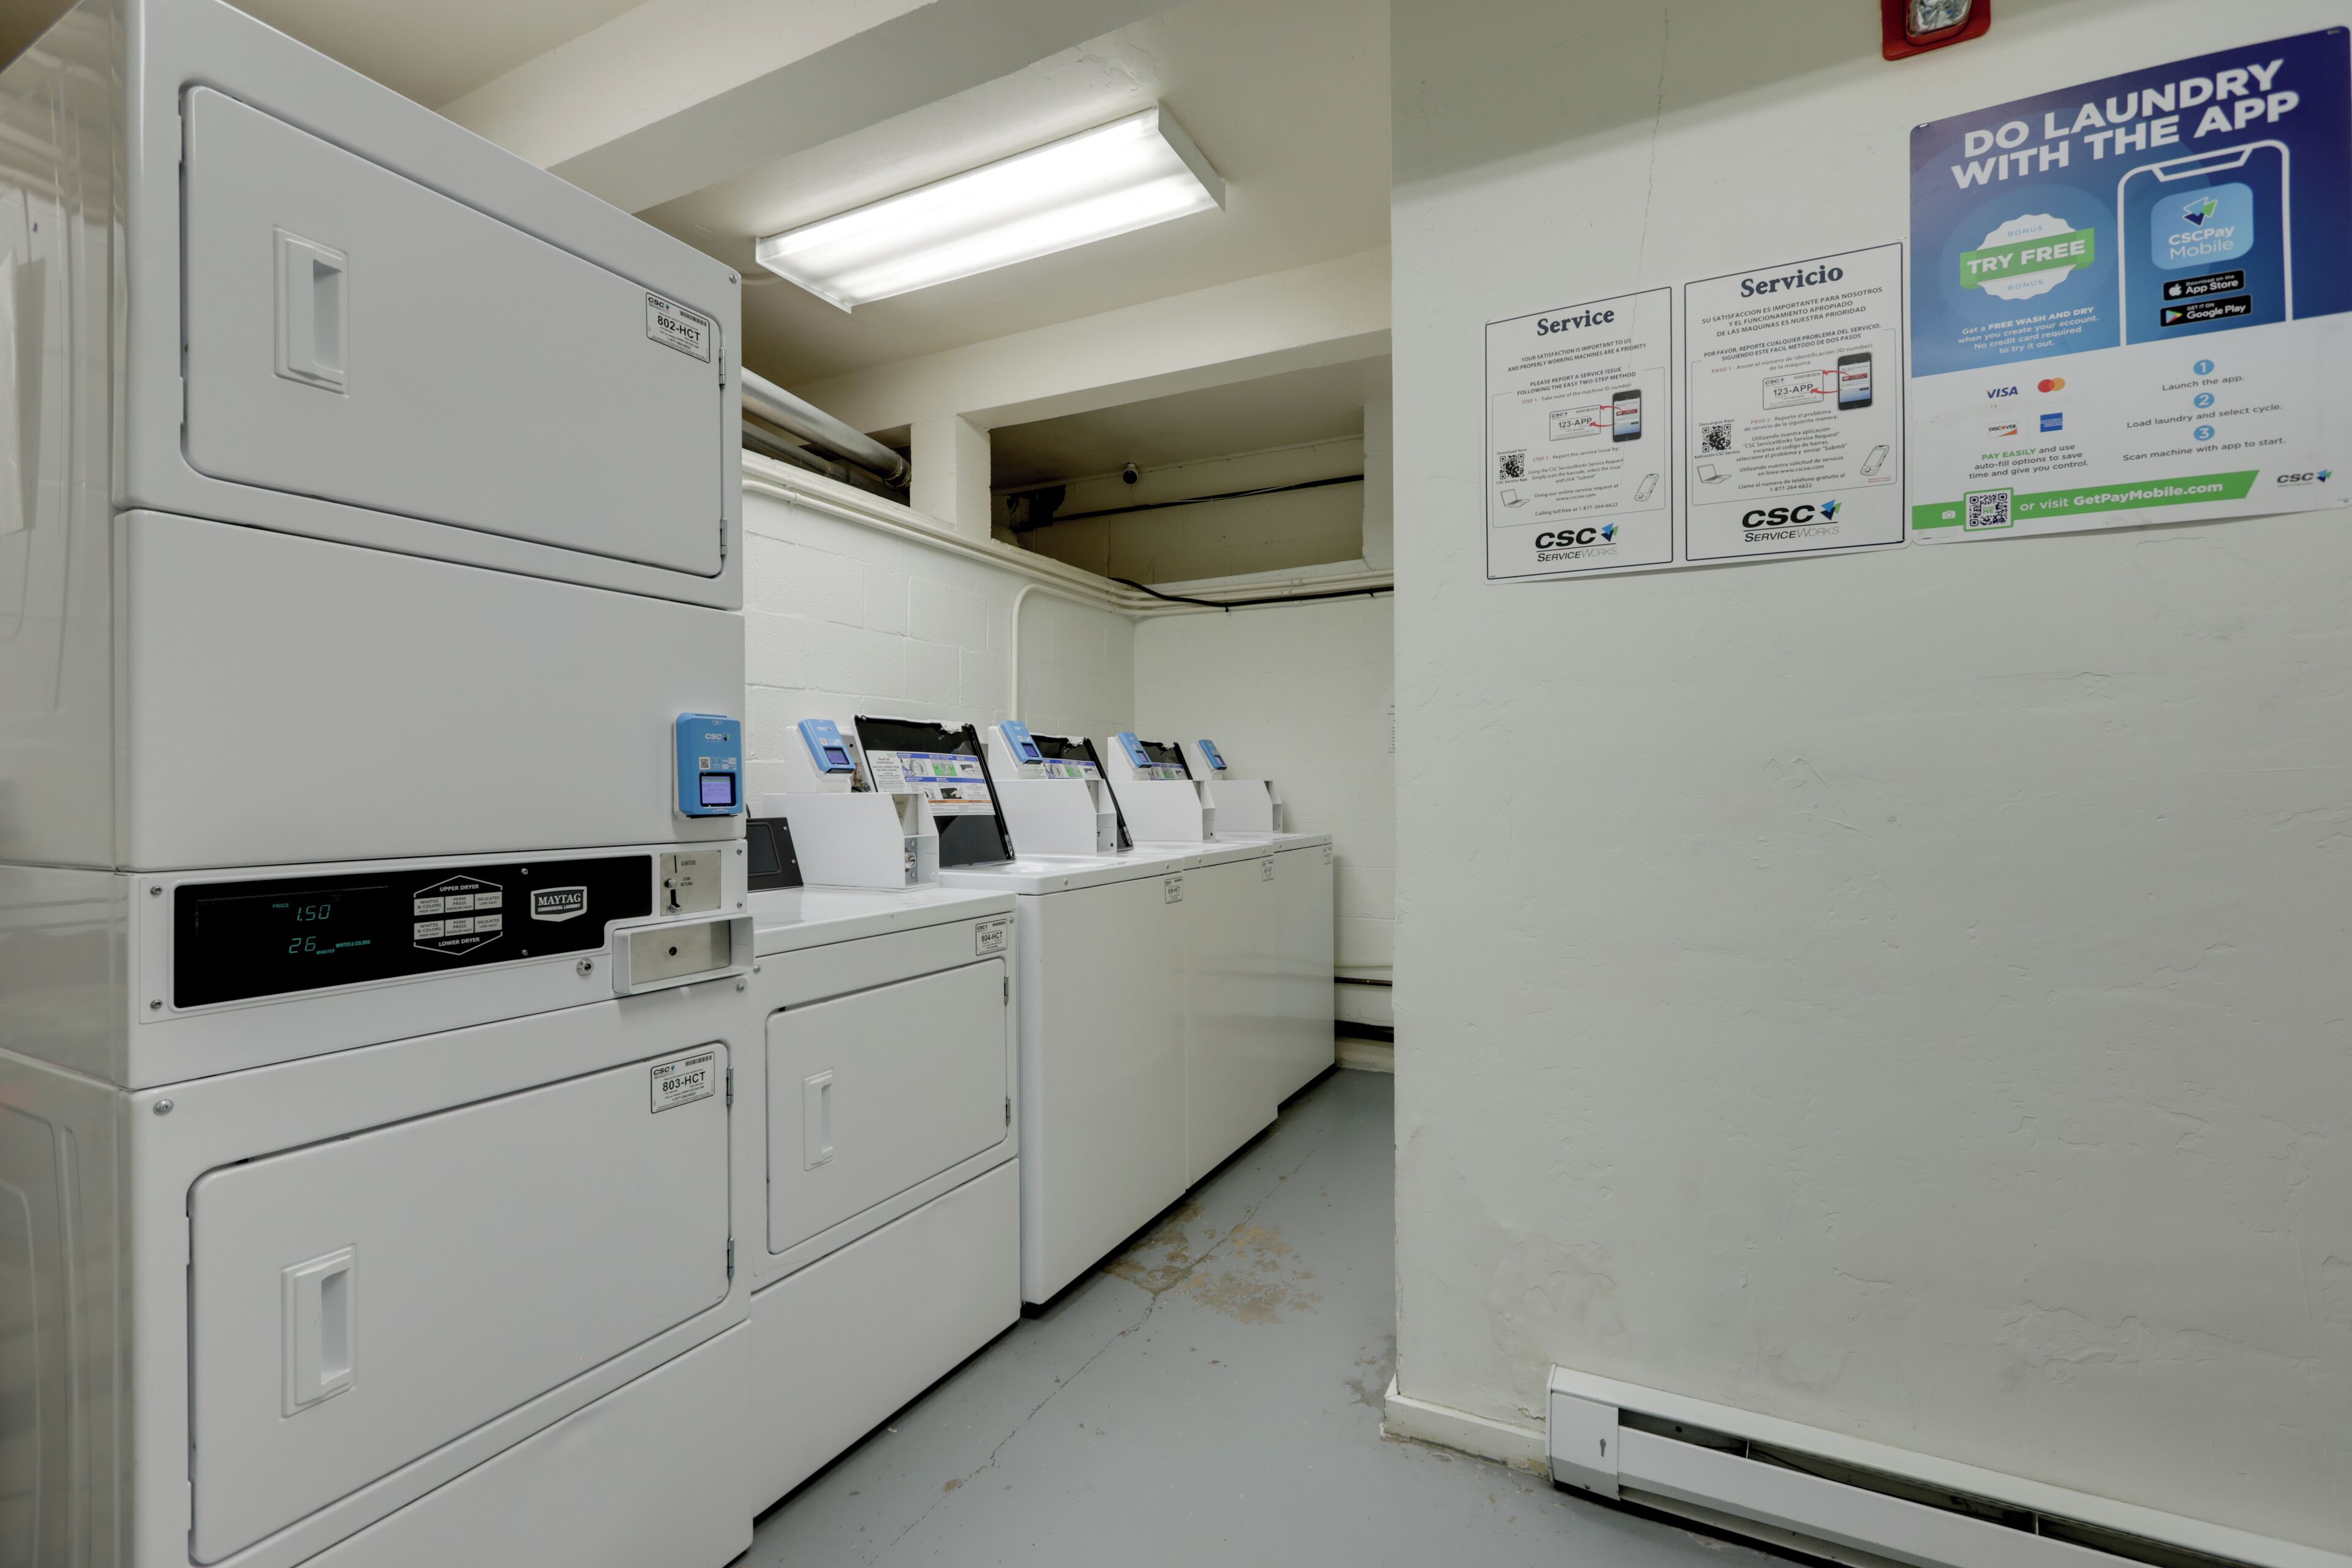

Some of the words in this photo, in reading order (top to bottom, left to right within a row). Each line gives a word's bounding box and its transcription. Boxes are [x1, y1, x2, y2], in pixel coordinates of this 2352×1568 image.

[1966, 121, 2029, 155] DO
[2045, 59, 2283, 139] LAUNDRY
[1951, 141, 2068, 189] WITH
[2084, 115, 2179, 159] THE
[2193, 91, 2299, 138] APP
[2008, 225, 2043, 237] BONUS
[2168, 227, 2234, 245] CSCPay
[1967, 253, 2014, 274] TRY
[2021, 239, 2085, 265] FREE
[2170, 239, 2233, 260] Mobile
[1741, 265, 1843, 298] Servicio
[2008, 279, 2043, 291] BONUS
[2185, 277, 2215, 287] Download
[2186, 285, 2207, 294] App
[2210, 281, 2238, 290] Store
[648, 296, 665, 307] CSC
[1713, 309, 1761, 322] SATISFACCION
[1773, 298, 1819, 311] IMPORTANTE
[1842, 287, 1882, 299] NOSOTROS
[1988, 320, 2013, 330] FREE
[2016, 315, 2046, 325] WASH
[2048, 311, 2071, 320] AND
[2073, 306, 2094, 316] DRY
[2187, 307, 2223, 319] Google
[2225, 304, 2246, 314] Play
[657, 315, 700, 341] 802-HCT
[1537, 310, 1615, 336] Service
[2003, 327, 2032, 336] create
[2035, 323, 2056, 332] your
[2058, 315, 2098, 327] account.
[1989, 337, 2016, 347] credit
[2018, 333, 2039, 342] card
[2042, 326, 2082, 338] required
[1520, 361, 1547, 369] PROPERLY
[1547, 356, 1574, 364] WORKING
[1574, 350, 1603, 360] MACHINES
[1621, 343, 1646, 352] PRIORITY
[1537, 349, 1575, 360] SATISFACTION
[1581, 341, 1614, 352] IMPORTANT
[2200, 362, 2206, 373] 1
[1517, 386, 1550, 395] FOLLOWING
[1579, 376, 1608, 385] TWO-STEP
[1610, 372, 1636, 380] METHOD
[2162, 381, 2199, 391] Launch
[1987, 386, 2018, 399] VISA
[2199, 394, 2209, 406] 2
[1558, 418, 1593, 428] 123-APP
[2127, 419, 2152, 428] Load
[2155, 415, 2193, 424] laundry
[2196, 411, 2215, 420] and
[2218, 407, 2250, 417] select
[2252, 404, 2282, 413] cycle.
[2199, 428, 2209, 439] 3
[2002, 448, 2036, 458] EASILY
[2150, 448, 2193, 458] machine
[2196, 444, 2218, 453] with
[2258, 437, 2286, 446] start.
[1975, 460, 2009, 470] auto-fill
[2012, 457, 2046, 466] options
[2052, 460, 2088, 469] control.
[2277, 473, 2314, 483] CSC
[2040, 498, 2068, 509] visit
[2073, 483, 2223, 505] GetPayMobile.com
[1742, 505, 1815, 528] CSC
[1535, 527, 1597, 549] CSC
[538, 893, 581, 906] MAYTAG
[297, 904, 331, 921] 1.50
[288, 937, 316, 954] 26
[981, 932, 1003, 942] 804-HCT
[654, 1066, 670, 1076] CSC
[662, 1071, 706, 1091] 803-HCT
